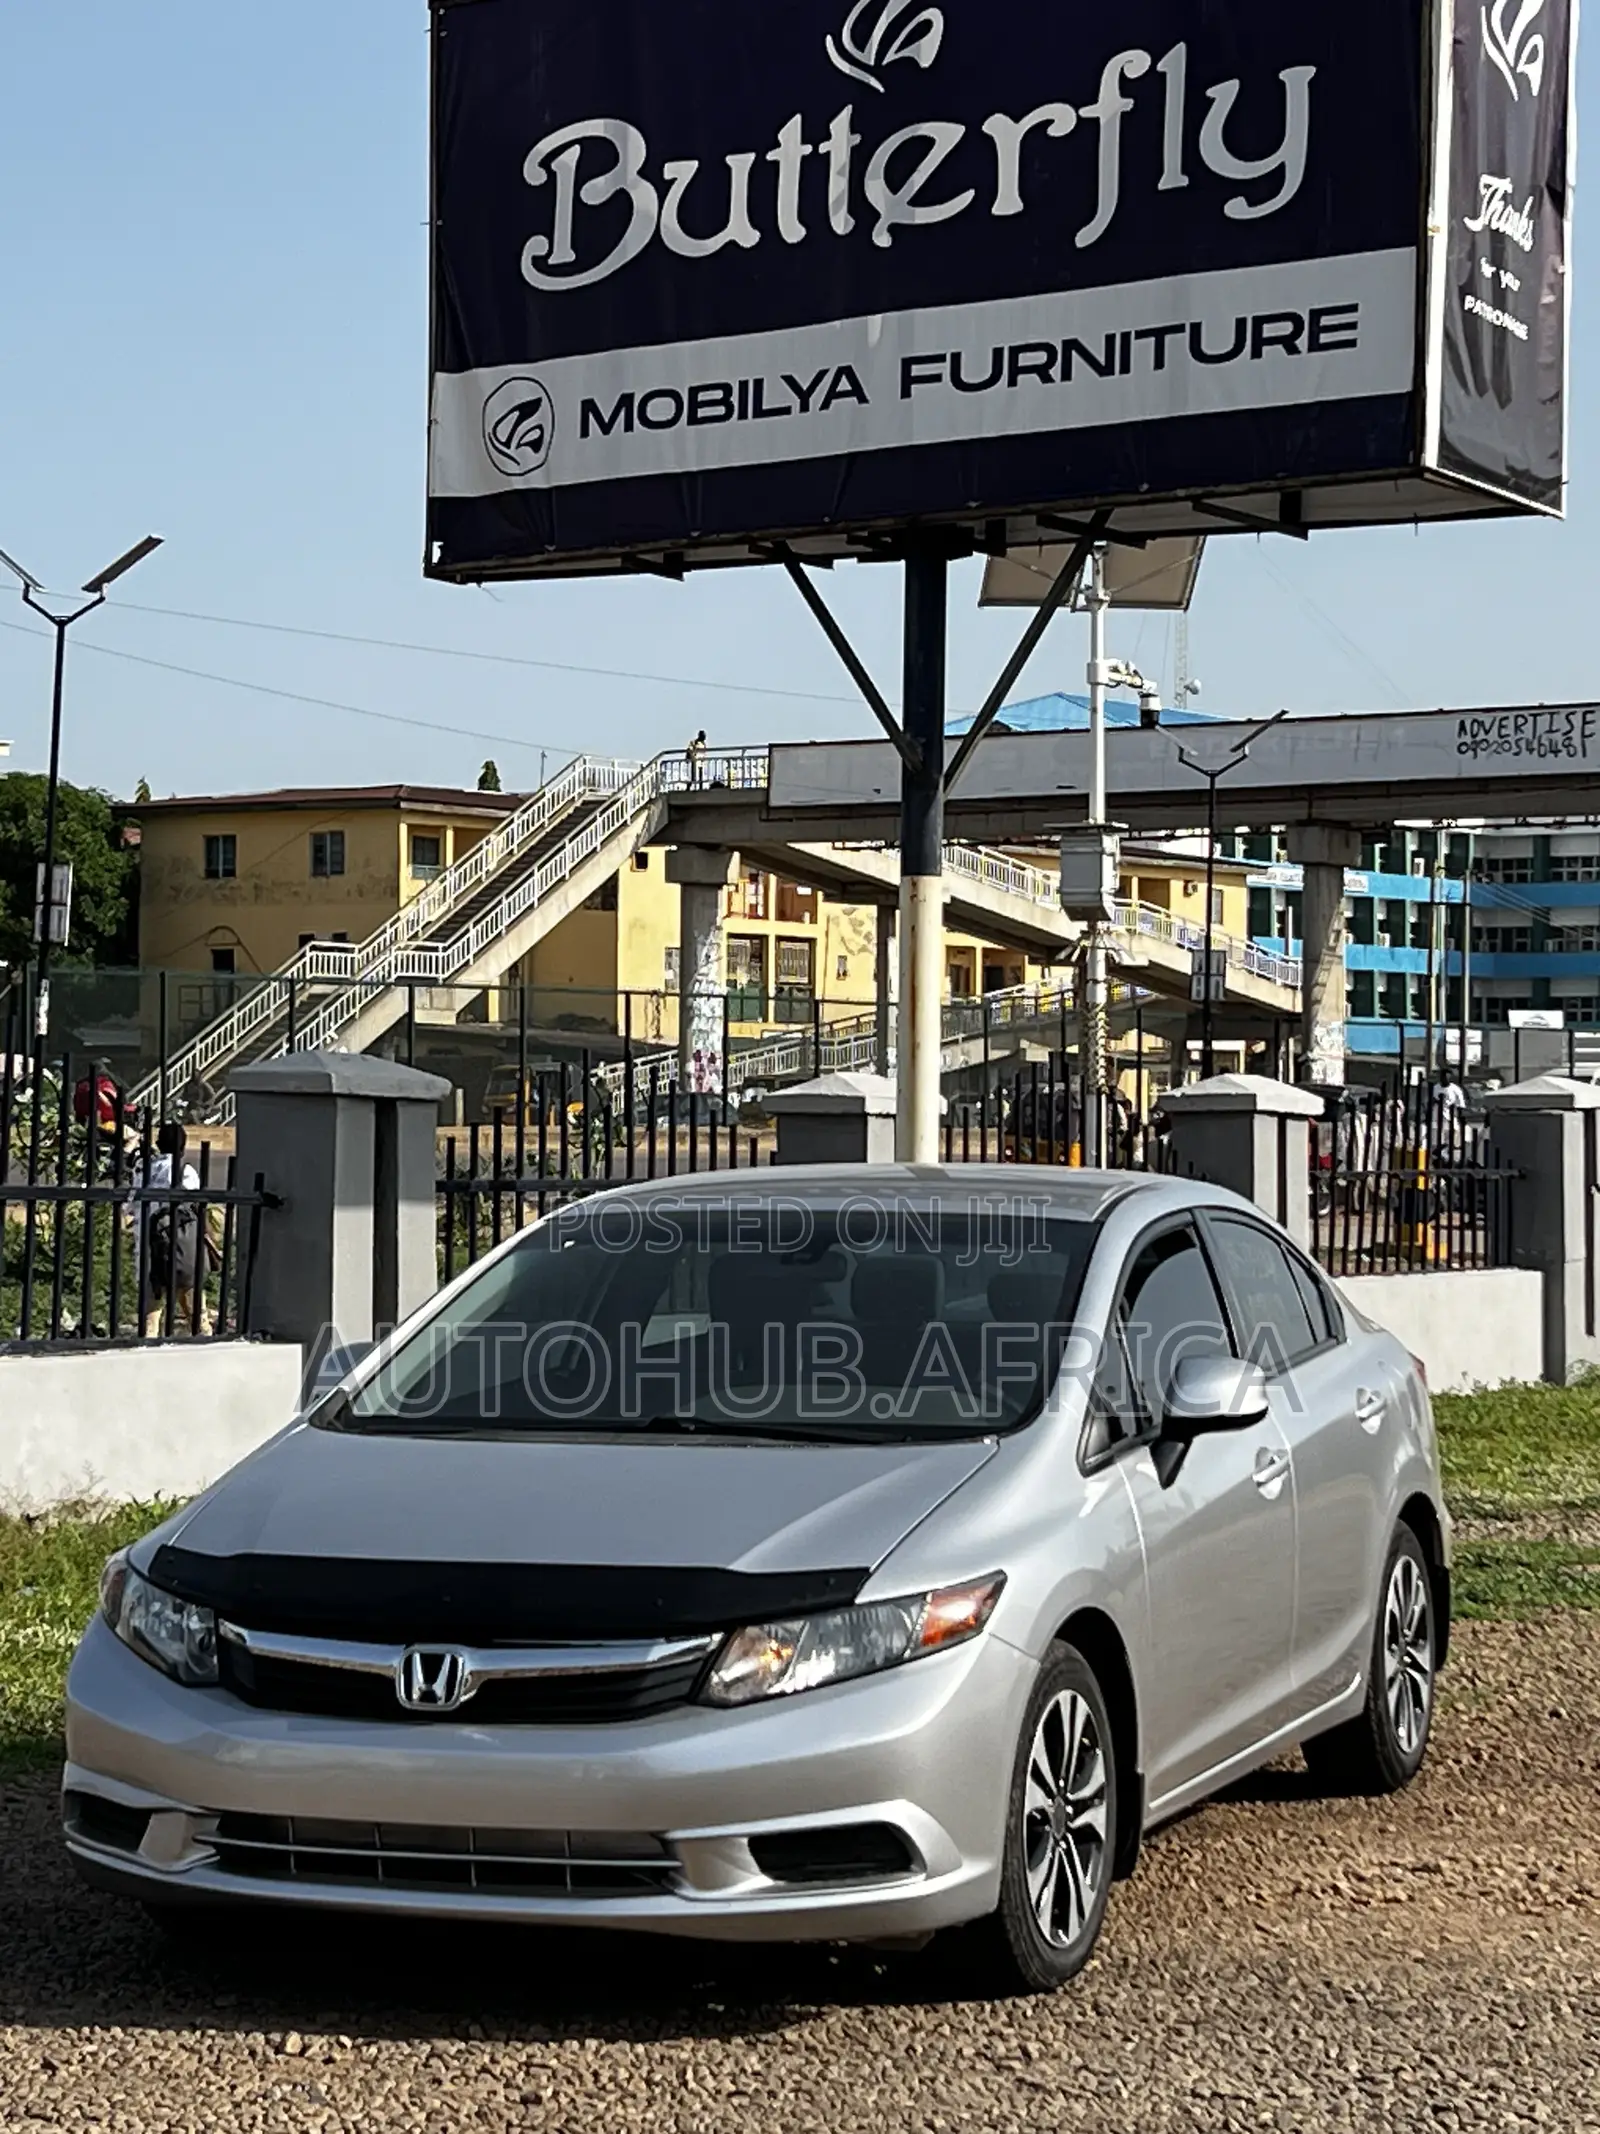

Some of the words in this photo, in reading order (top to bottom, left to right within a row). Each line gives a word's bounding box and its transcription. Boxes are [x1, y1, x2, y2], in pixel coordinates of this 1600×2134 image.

[520, 41, 1317, 291] Butterfly
[1463, 173, 1534, 252] Thanks
[579, 364, 870, 439] MOBILYA
[900, 302, 1359, 400] FURNITURE
[1457, 709, 1596, 739] ADVERTISE
